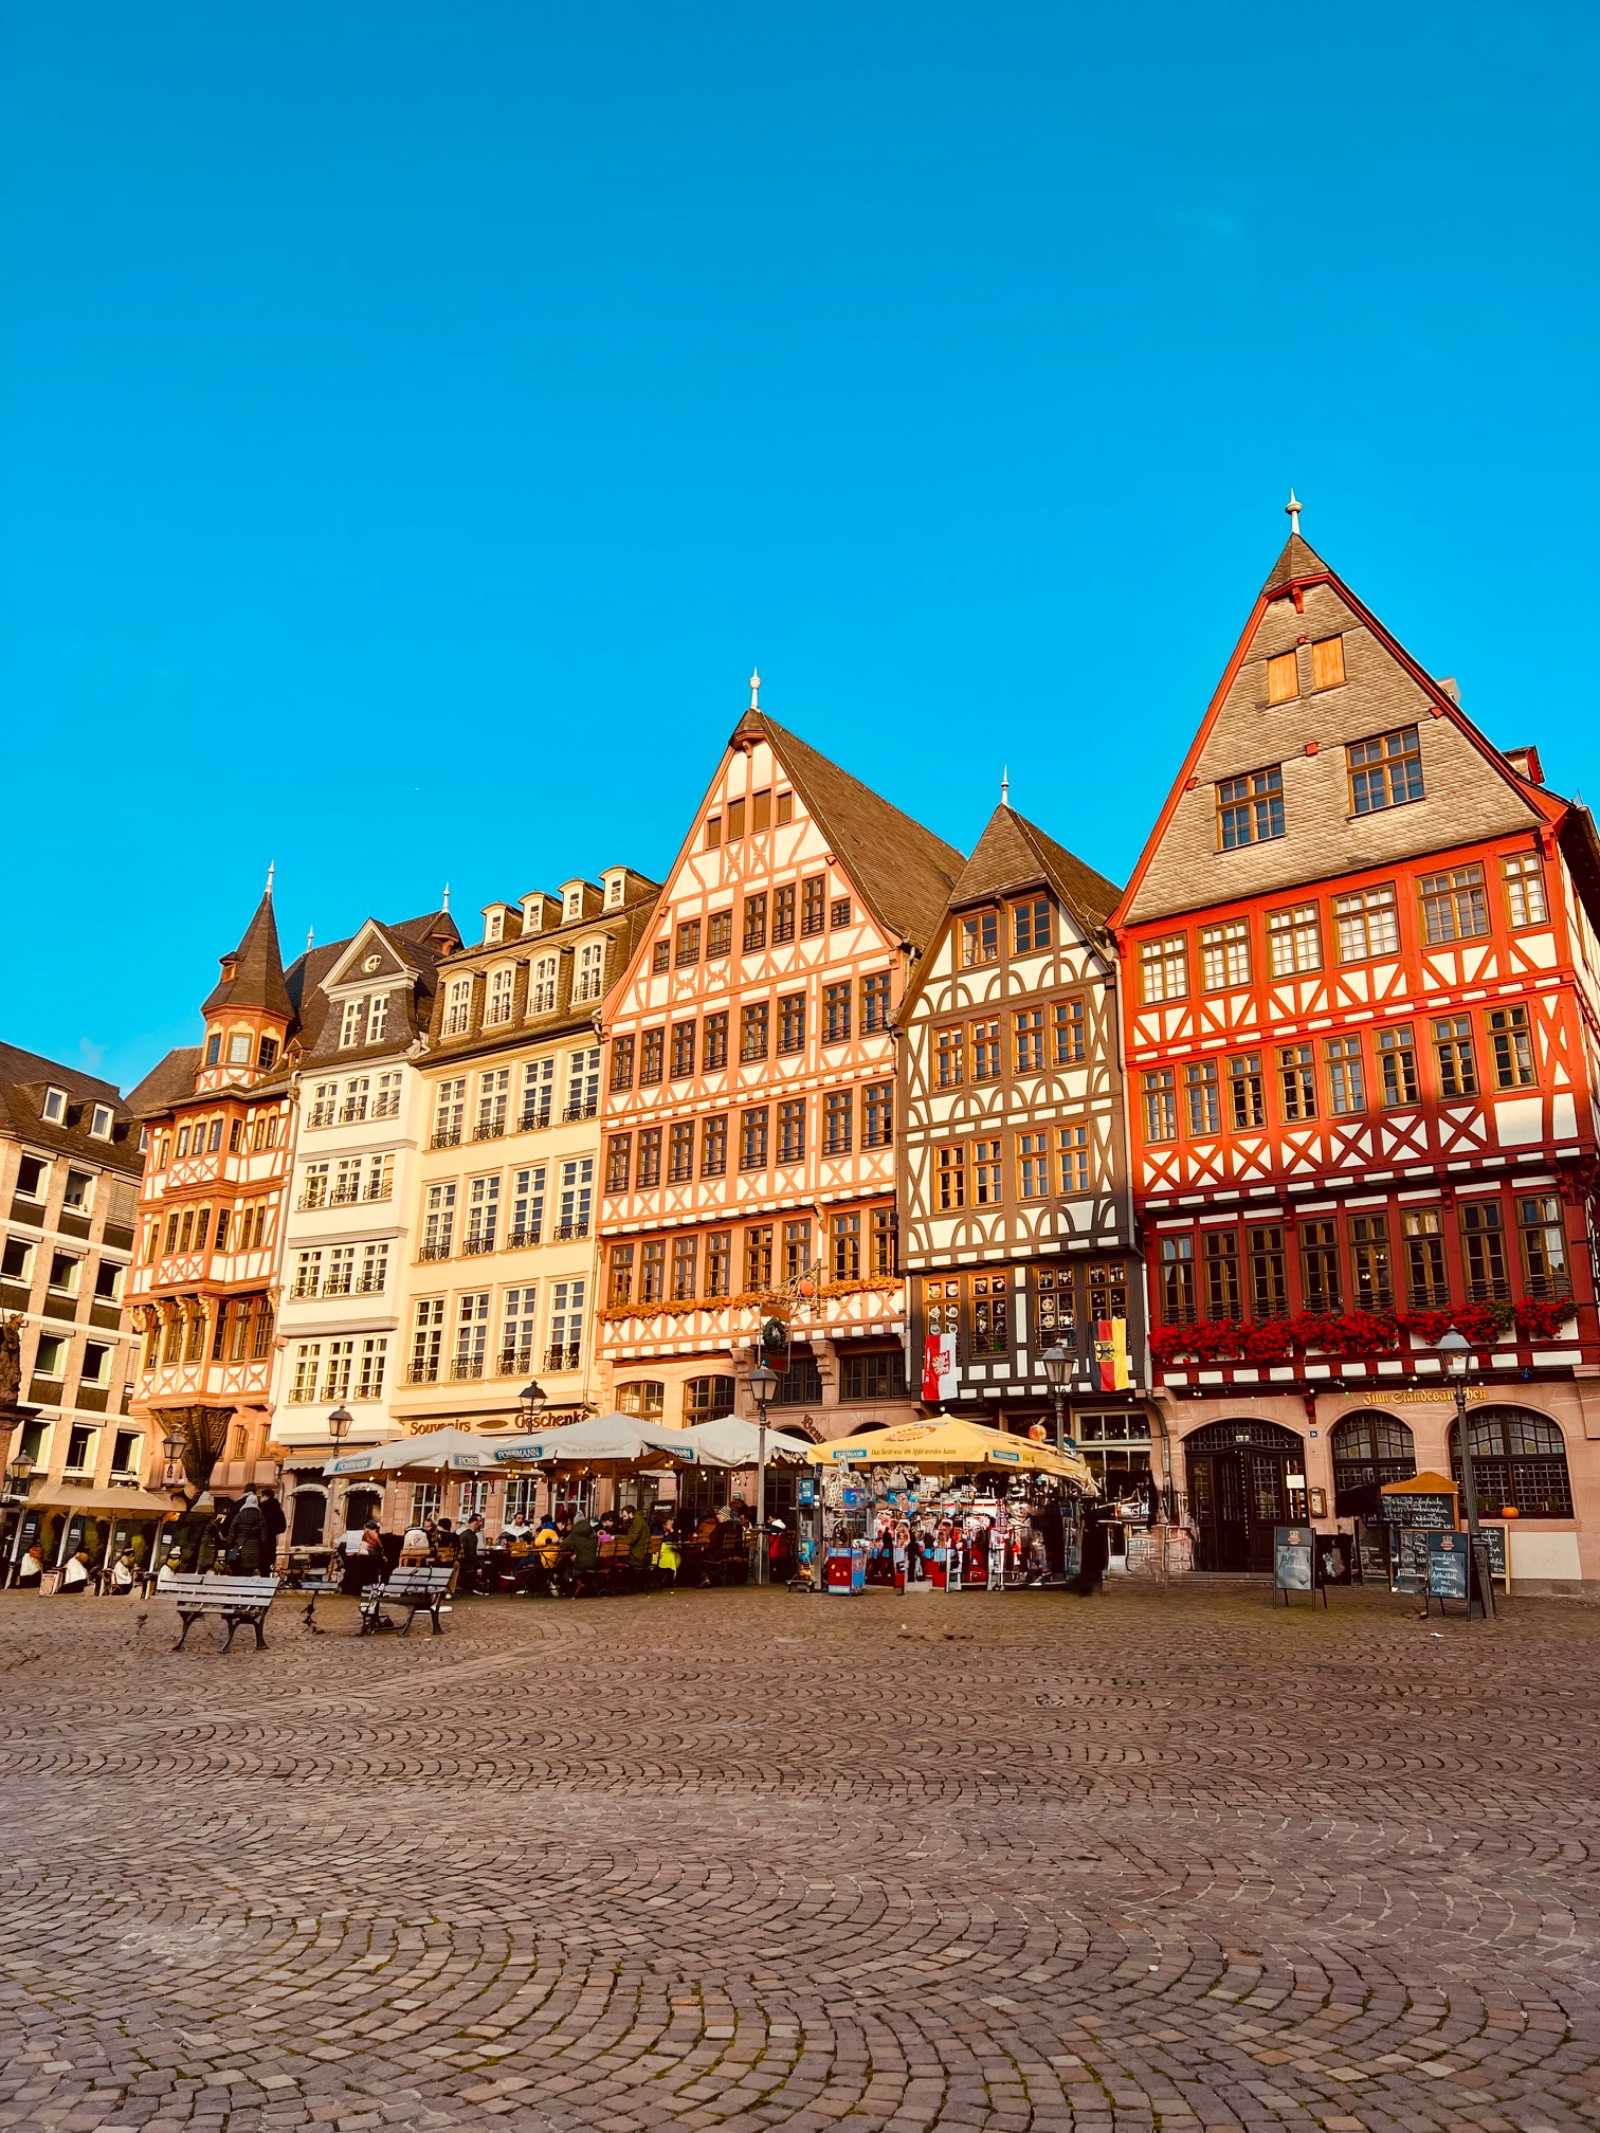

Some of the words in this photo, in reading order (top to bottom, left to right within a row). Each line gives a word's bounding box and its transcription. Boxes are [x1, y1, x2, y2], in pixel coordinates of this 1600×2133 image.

[1363, 1391, 1389, 1406] Zum
[1392, 1387, 1487, 1404] Standesämchen
[498, 1448, 540, 1460] POSSMANN
